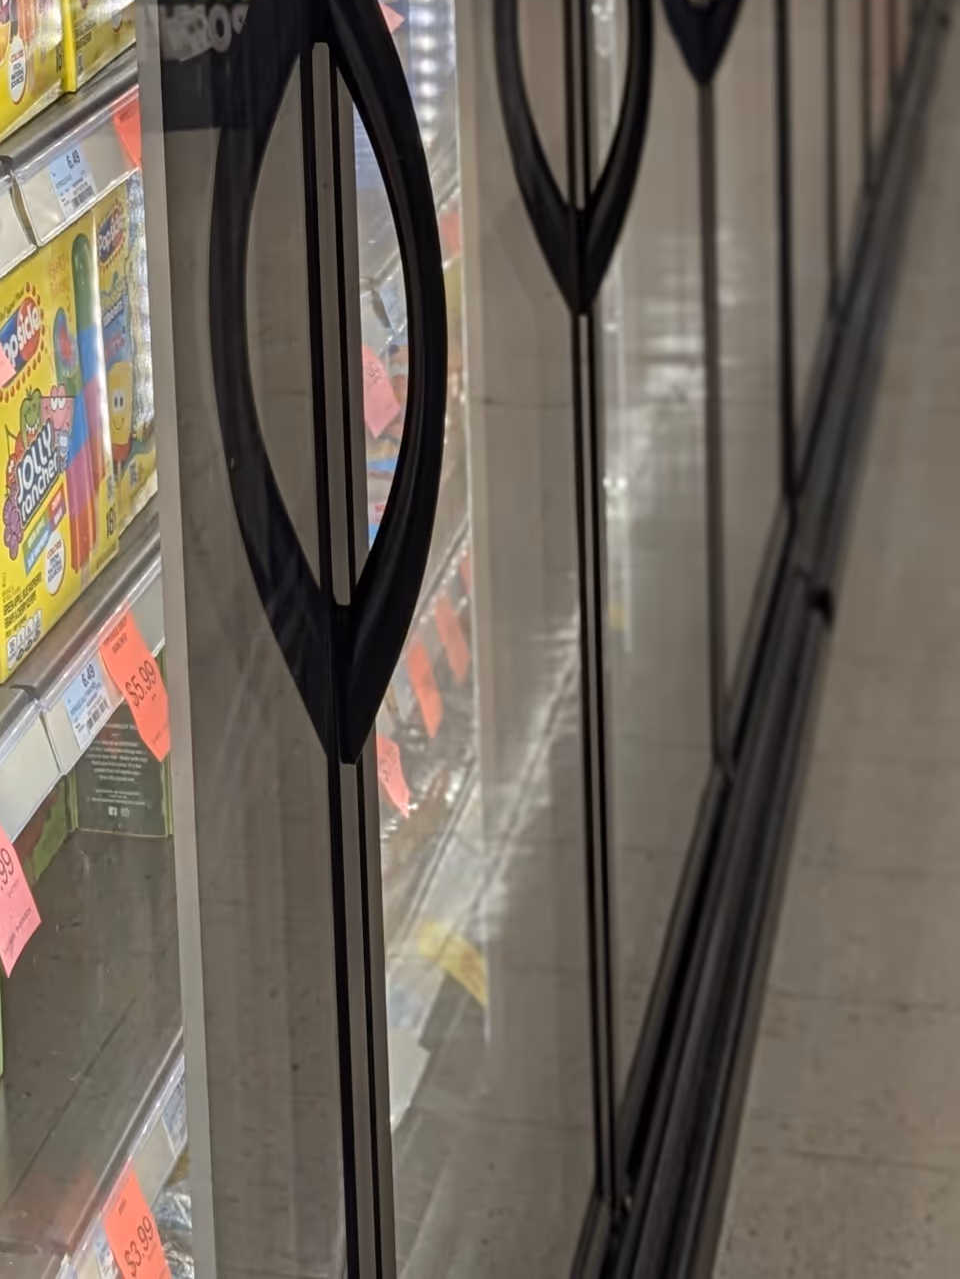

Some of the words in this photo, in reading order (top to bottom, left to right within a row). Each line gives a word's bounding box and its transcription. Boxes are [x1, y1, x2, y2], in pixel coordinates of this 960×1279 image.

[66, 149, 81, 170] 6.49
[0, 302, 40, 371] opsicle
[17, 421, 52, 503] JOLLY
[21, 452, 58, 522] rancher
[47, 538, 62, 560] COLORS
[81, 663, 95, 688] 6.49
[125, 658, 157, 709] $5.99
[124, 1215, 155, 1278] $3.99
